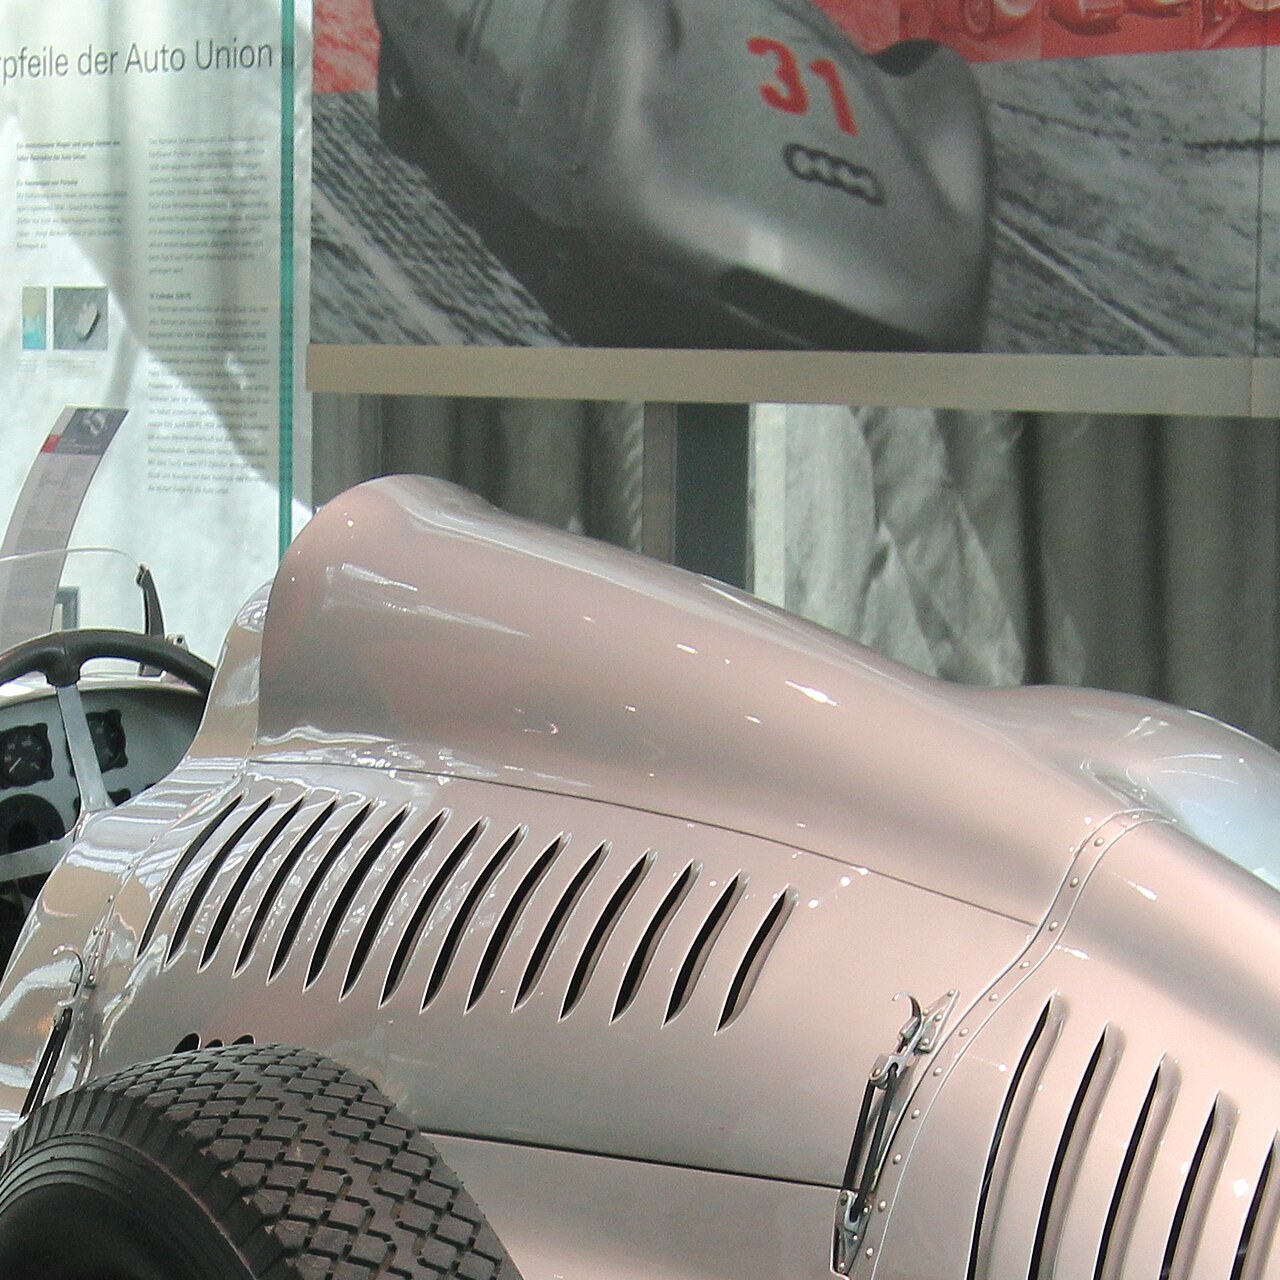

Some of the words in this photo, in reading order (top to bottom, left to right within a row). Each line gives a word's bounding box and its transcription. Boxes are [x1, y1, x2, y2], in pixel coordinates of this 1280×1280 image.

[77, 44, 118, 76] der
[124, 42, 186, 72] Auto
[195, 37, 273, 70] Union
[746, 35, 859, 136] 31
